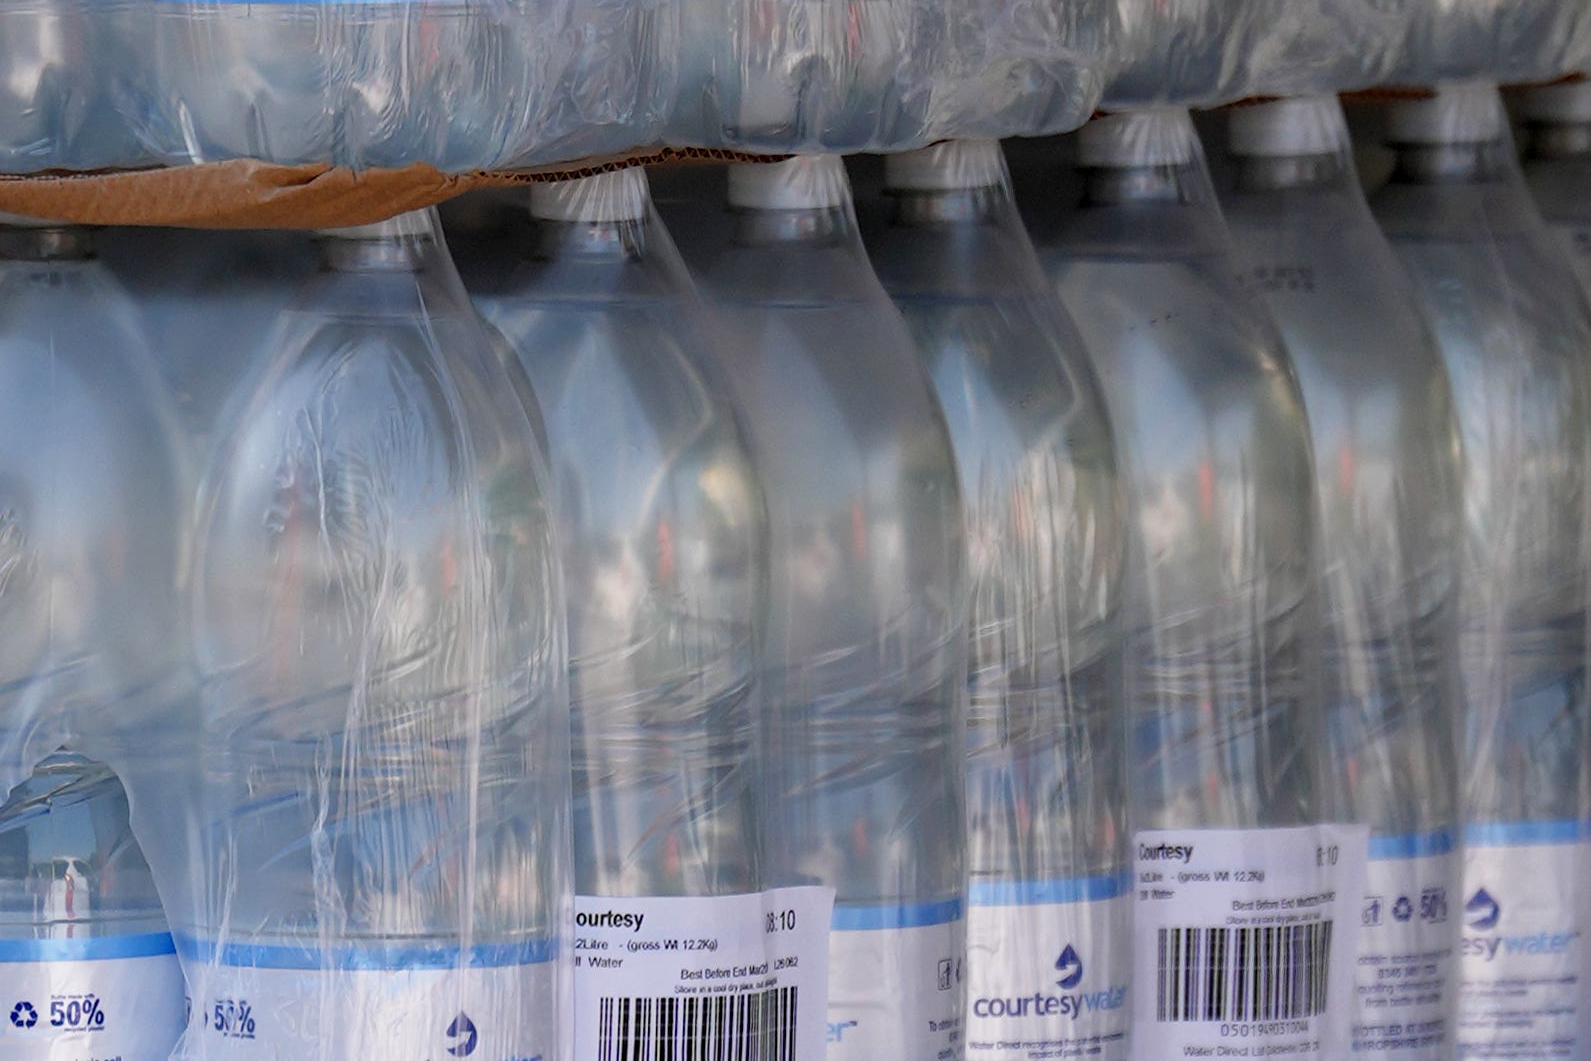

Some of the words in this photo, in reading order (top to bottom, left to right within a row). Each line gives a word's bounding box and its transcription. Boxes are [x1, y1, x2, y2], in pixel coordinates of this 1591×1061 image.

[1139, 843, 1193, 864] Courtesy
[627, 939, 661, 953] (gross
[588, 957, 624, 968] Water
[50, 999, 104, 1027] 50%
